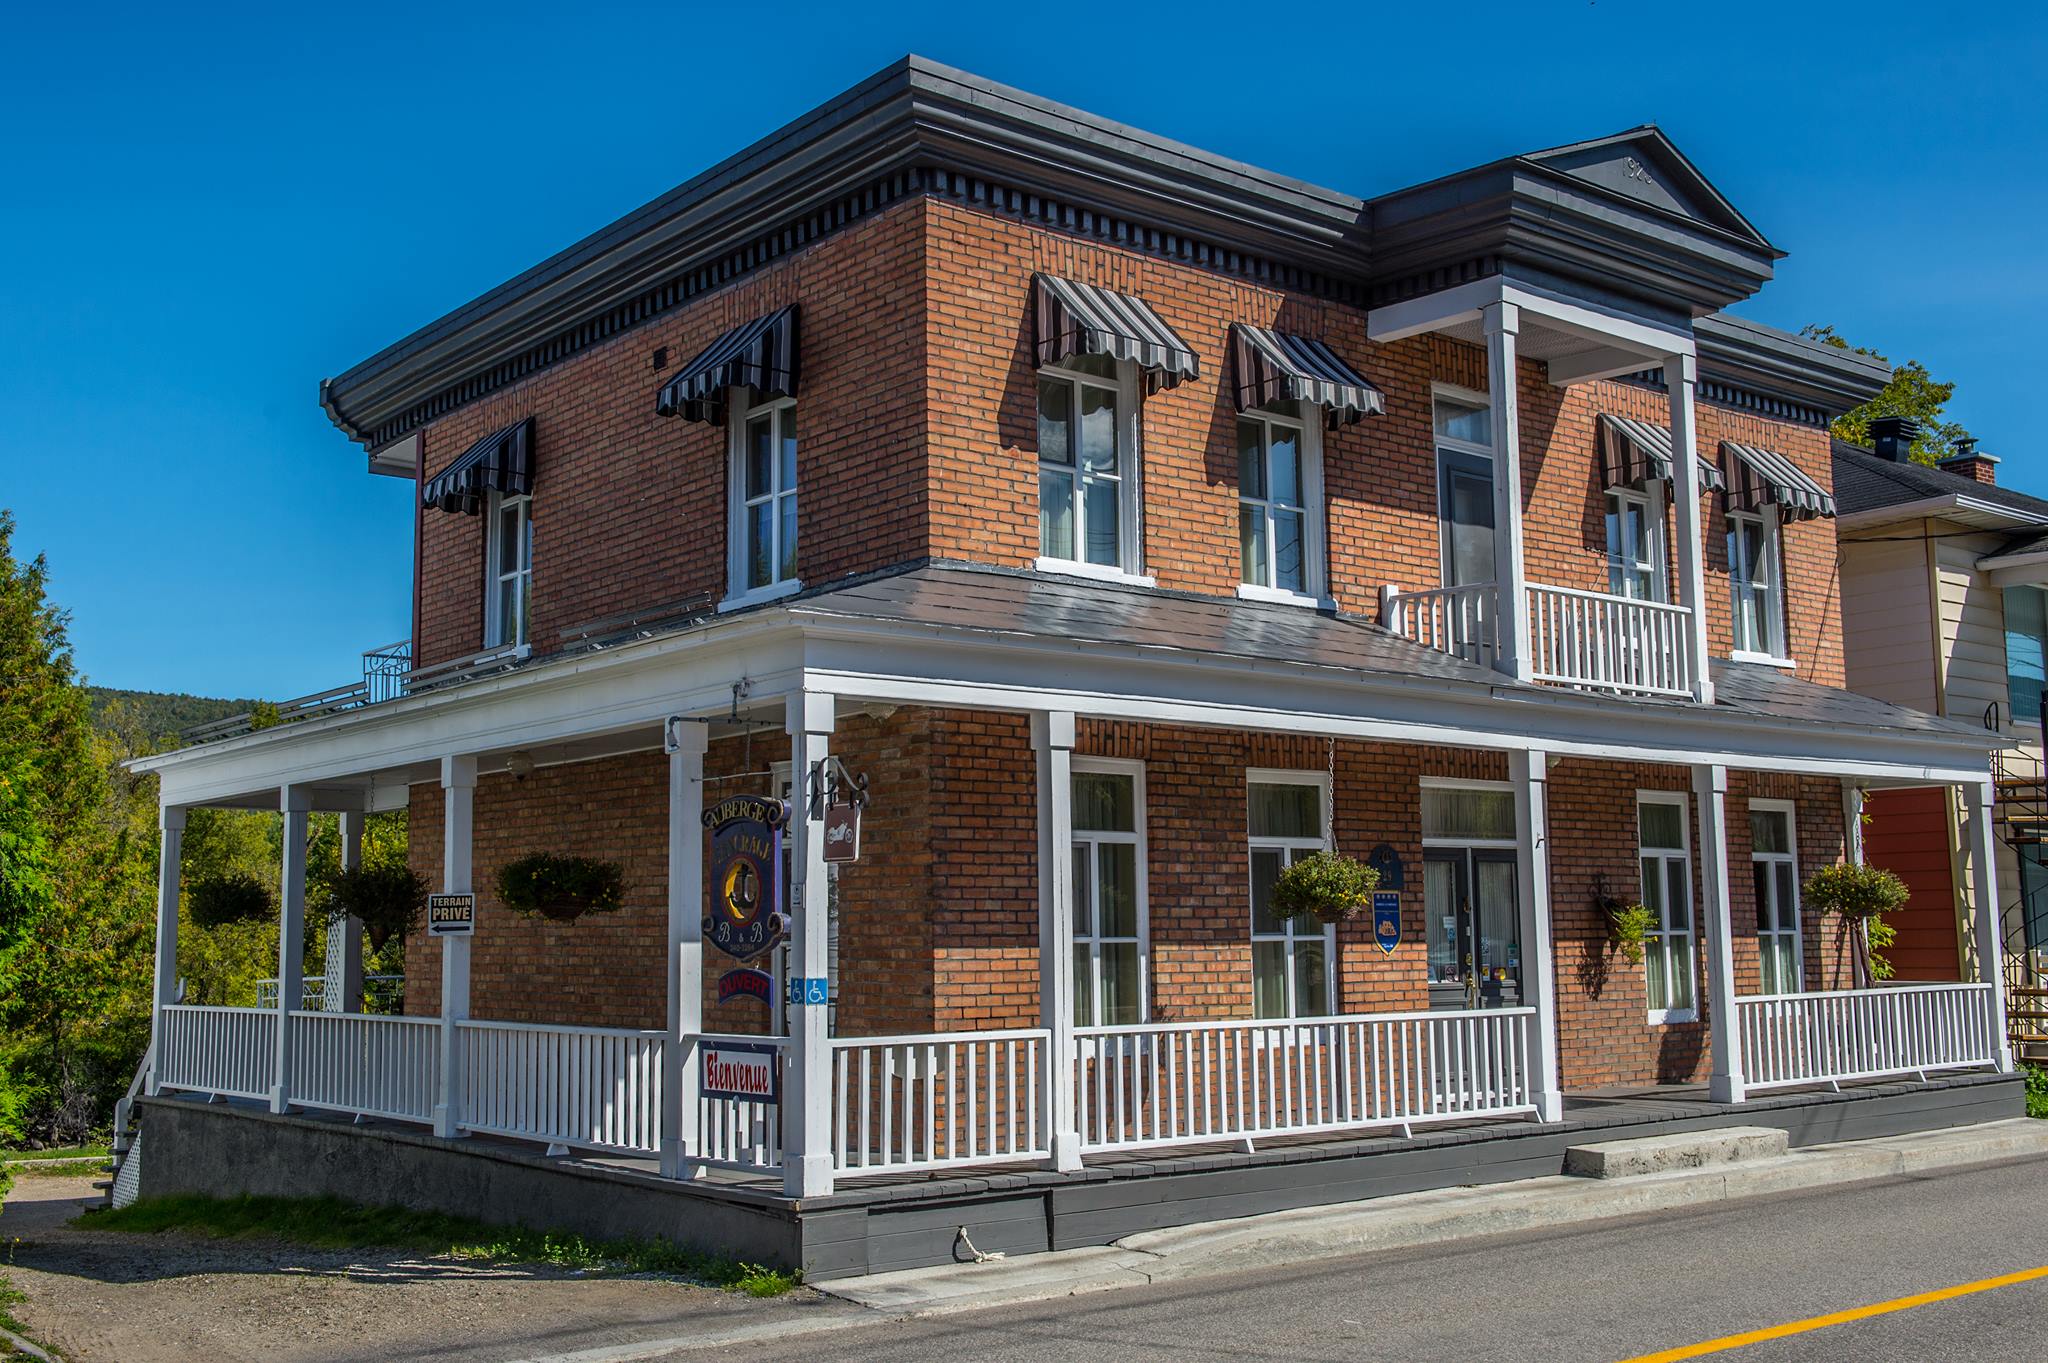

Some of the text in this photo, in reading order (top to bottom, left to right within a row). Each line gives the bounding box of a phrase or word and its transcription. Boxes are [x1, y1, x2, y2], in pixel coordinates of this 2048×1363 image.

[711, 800, 765, 828] AUBERGE
[432, 897, 471, 906] TERRAIN
[432, 906, 470, 921] PRIVÉ
[718, 922, 731, 942] B
[750, 922, 763, 942] B
[719, 973, 769, 996] OUVERT
[706, 1051, 769, 1094] Bienvenue
